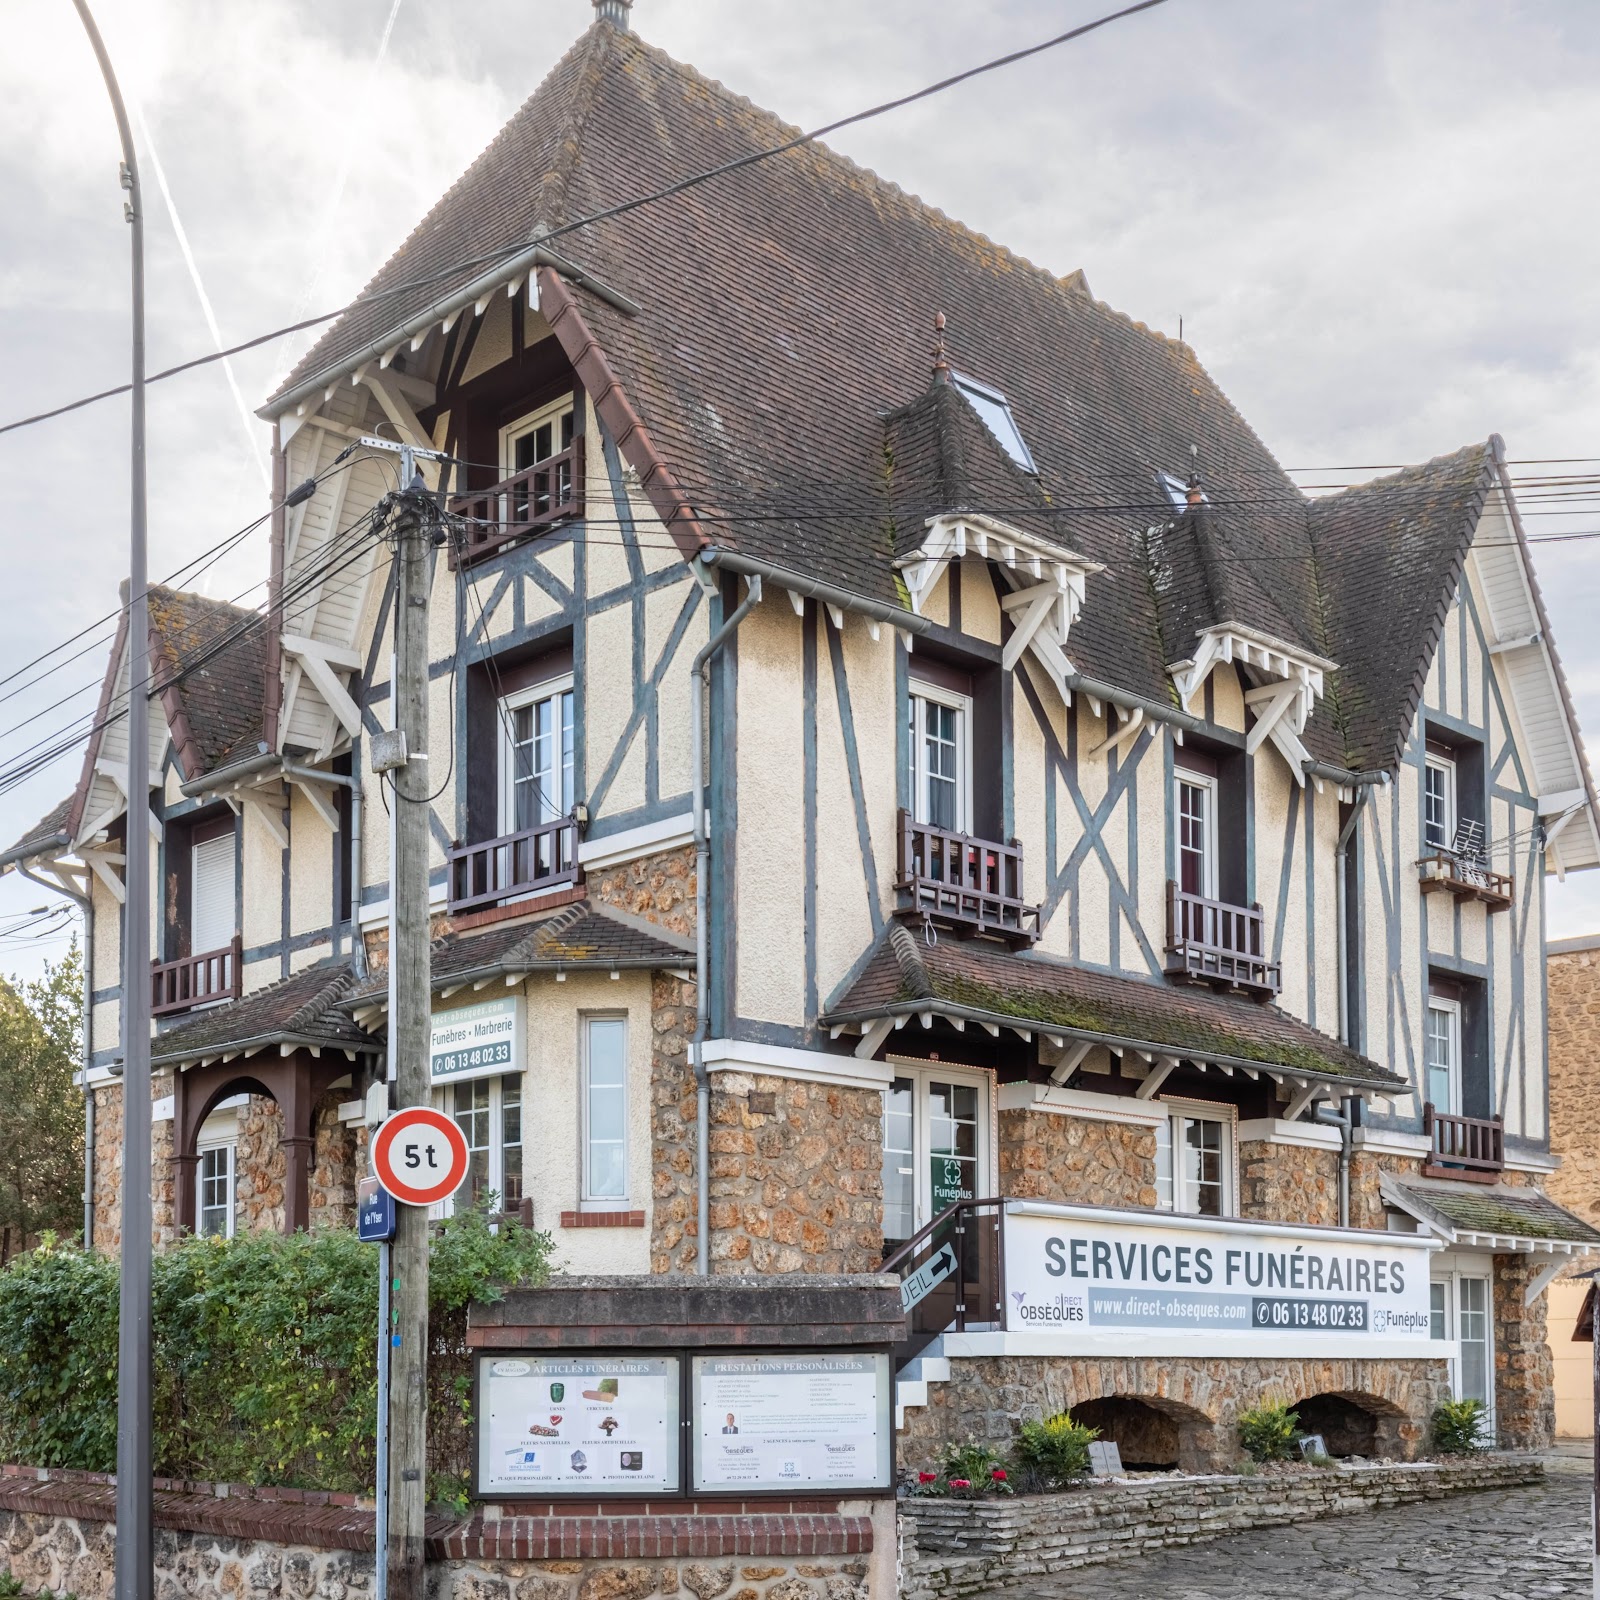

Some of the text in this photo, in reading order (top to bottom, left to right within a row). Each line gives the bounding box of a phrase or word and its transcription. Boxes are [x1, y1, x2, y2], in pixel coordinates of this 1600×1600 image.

[431, 1002, 504, 1026] rect-obseques.com
[432, 1017, 513, 1046] Funèbres Marbrerie
[444, 1044, 508, 1071] 06 13 48 02 33
[369, 1193, 378, 1206] Rue
[934, 1185, 973, 1202] Funéplus
[364, 1211, 383, 1225] de l'Yser
[1045, 1236, 1406, 1294] SERVICES FUNÉRAIRES
[903, 1272, 933, 1307] UEIL
[1055, 1294, 1082, 1306] DIRECT
[1020, 1300, 1084, 1321] OBSÈQUES
[1093, 1296, 1246, 1321] www.direct-obseques.com
[1272, 1302, 1364, 1327] 06 13 48 02 33
[1386, 1310, 1428, 1333] Funéplus
[533, 1362, 650, 1374] ARTICLES FUNÉRAIRES
[714, 1360, 863, 1372] PRESTATIONS PERSONALISÉES
